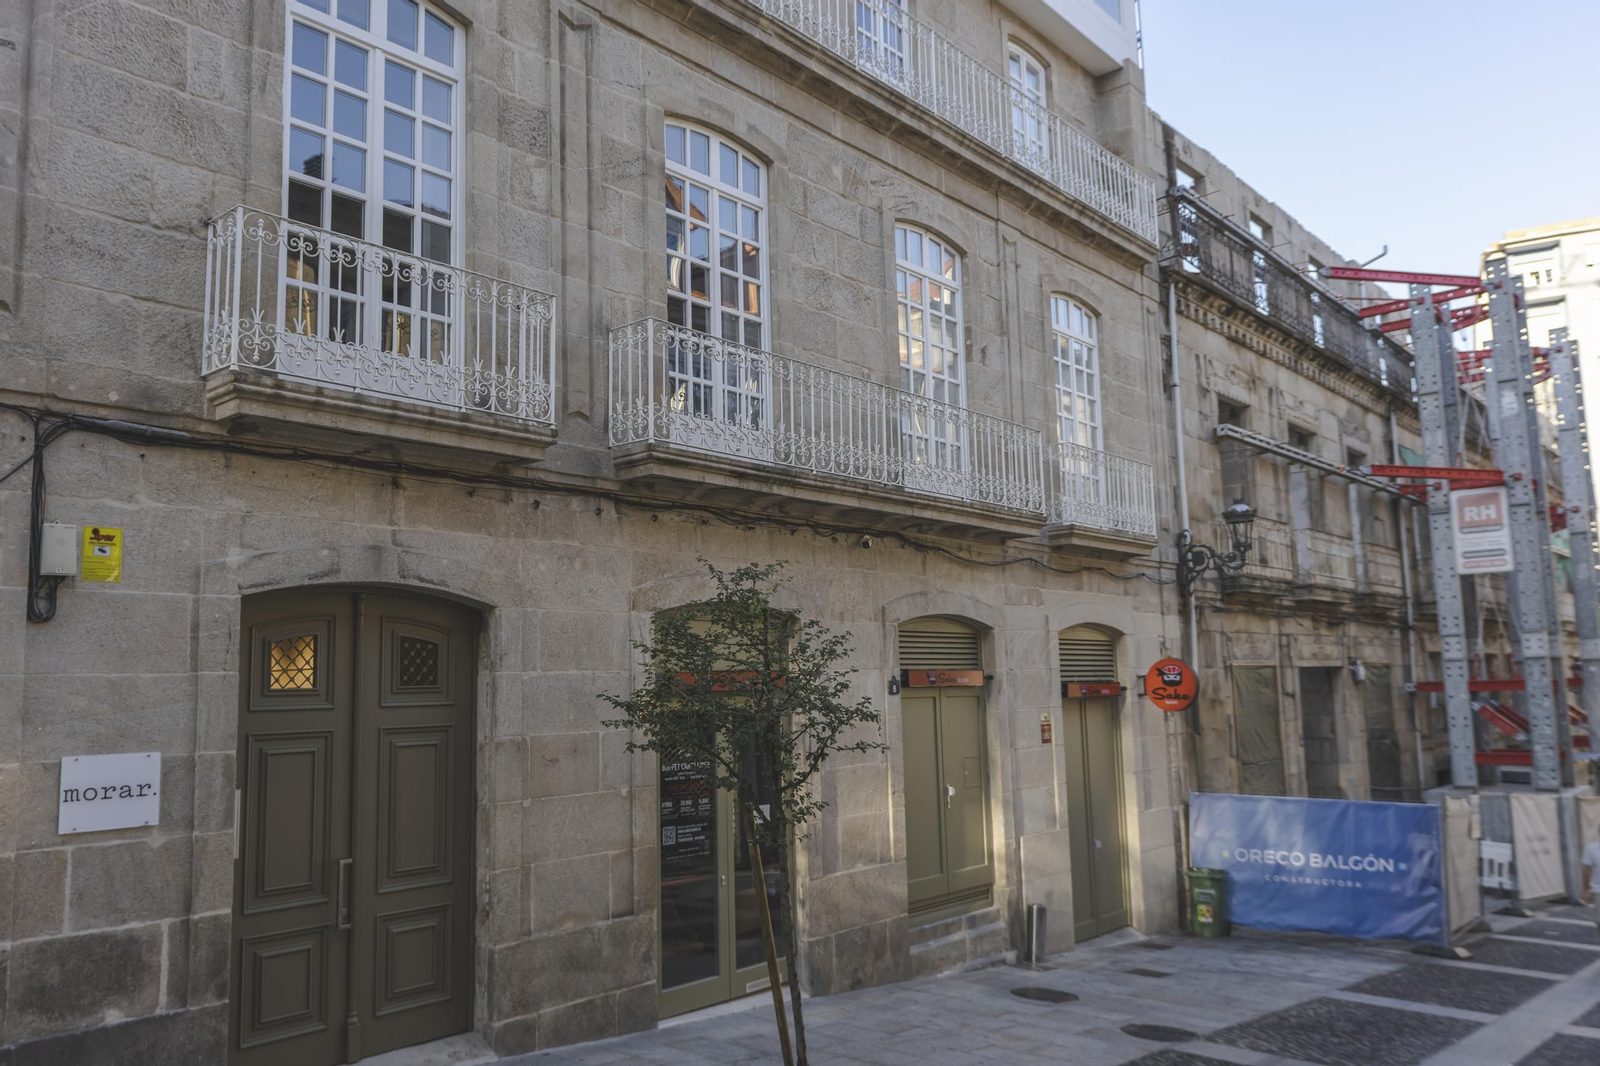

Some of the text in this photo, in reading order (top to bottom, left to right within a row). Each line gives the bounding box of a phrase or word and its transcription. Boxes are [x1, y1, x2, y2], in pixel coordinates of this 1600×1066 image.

[1463, 504, 1497, 522] RH
[1152, 687, 1190, 700] Sake
[62, 783, 157, 803] morar.
[1234, 848, 1395, 873] ORECO BALGÓN
[1264, 874, 1362, 888] CONSTRUCTORA
